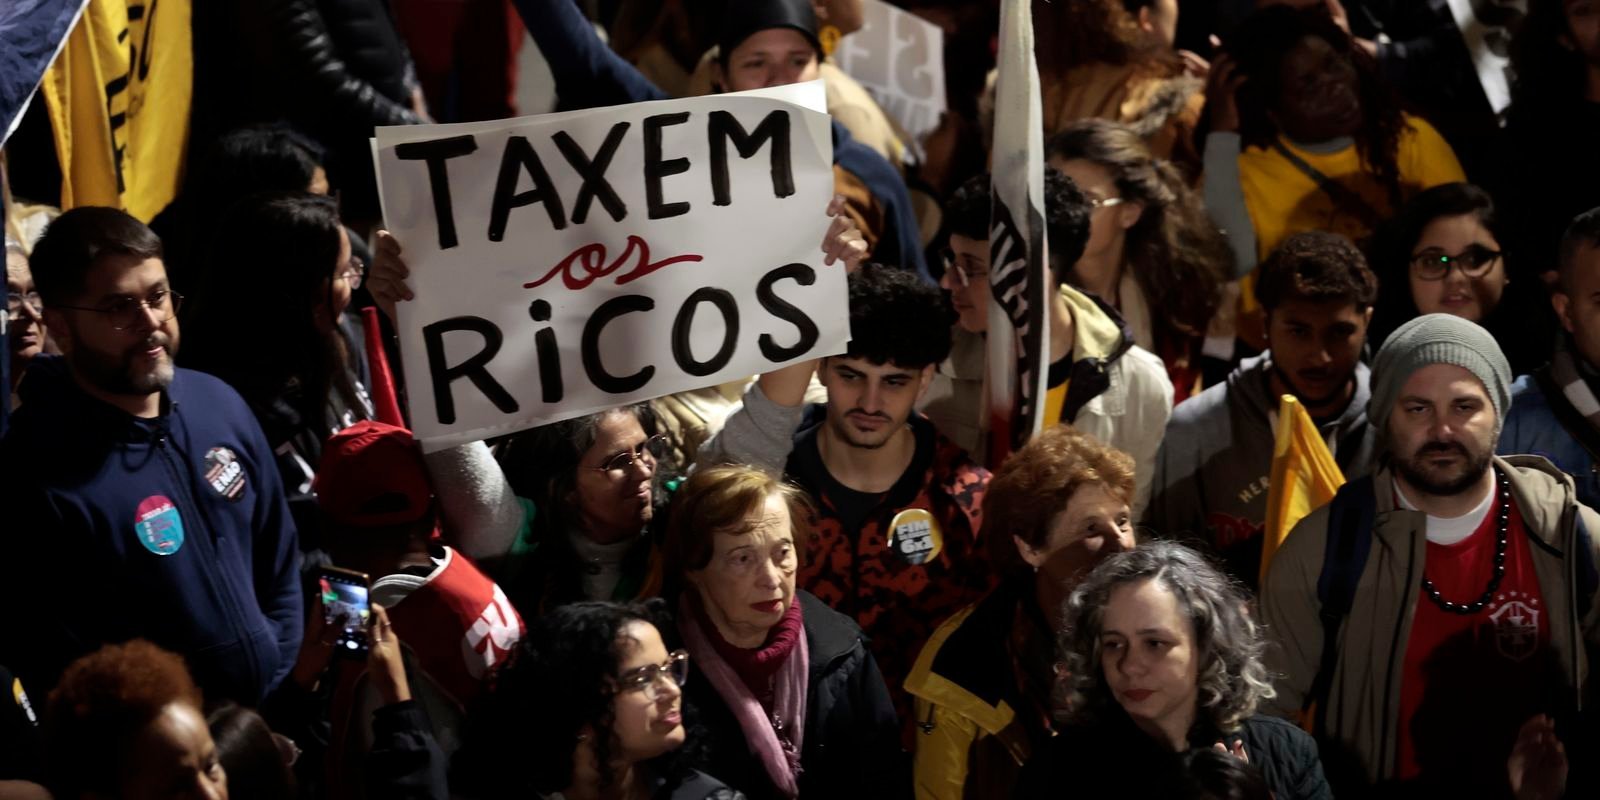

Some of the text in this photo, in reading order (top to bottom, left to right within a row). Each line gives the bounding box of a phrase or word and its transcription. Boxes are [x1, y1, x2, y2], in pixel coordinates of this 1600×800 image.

[396, 109, 795, 249] TAXEM
[524, 235, 703, 290] os
[897, 520, 931, 535] FIM
